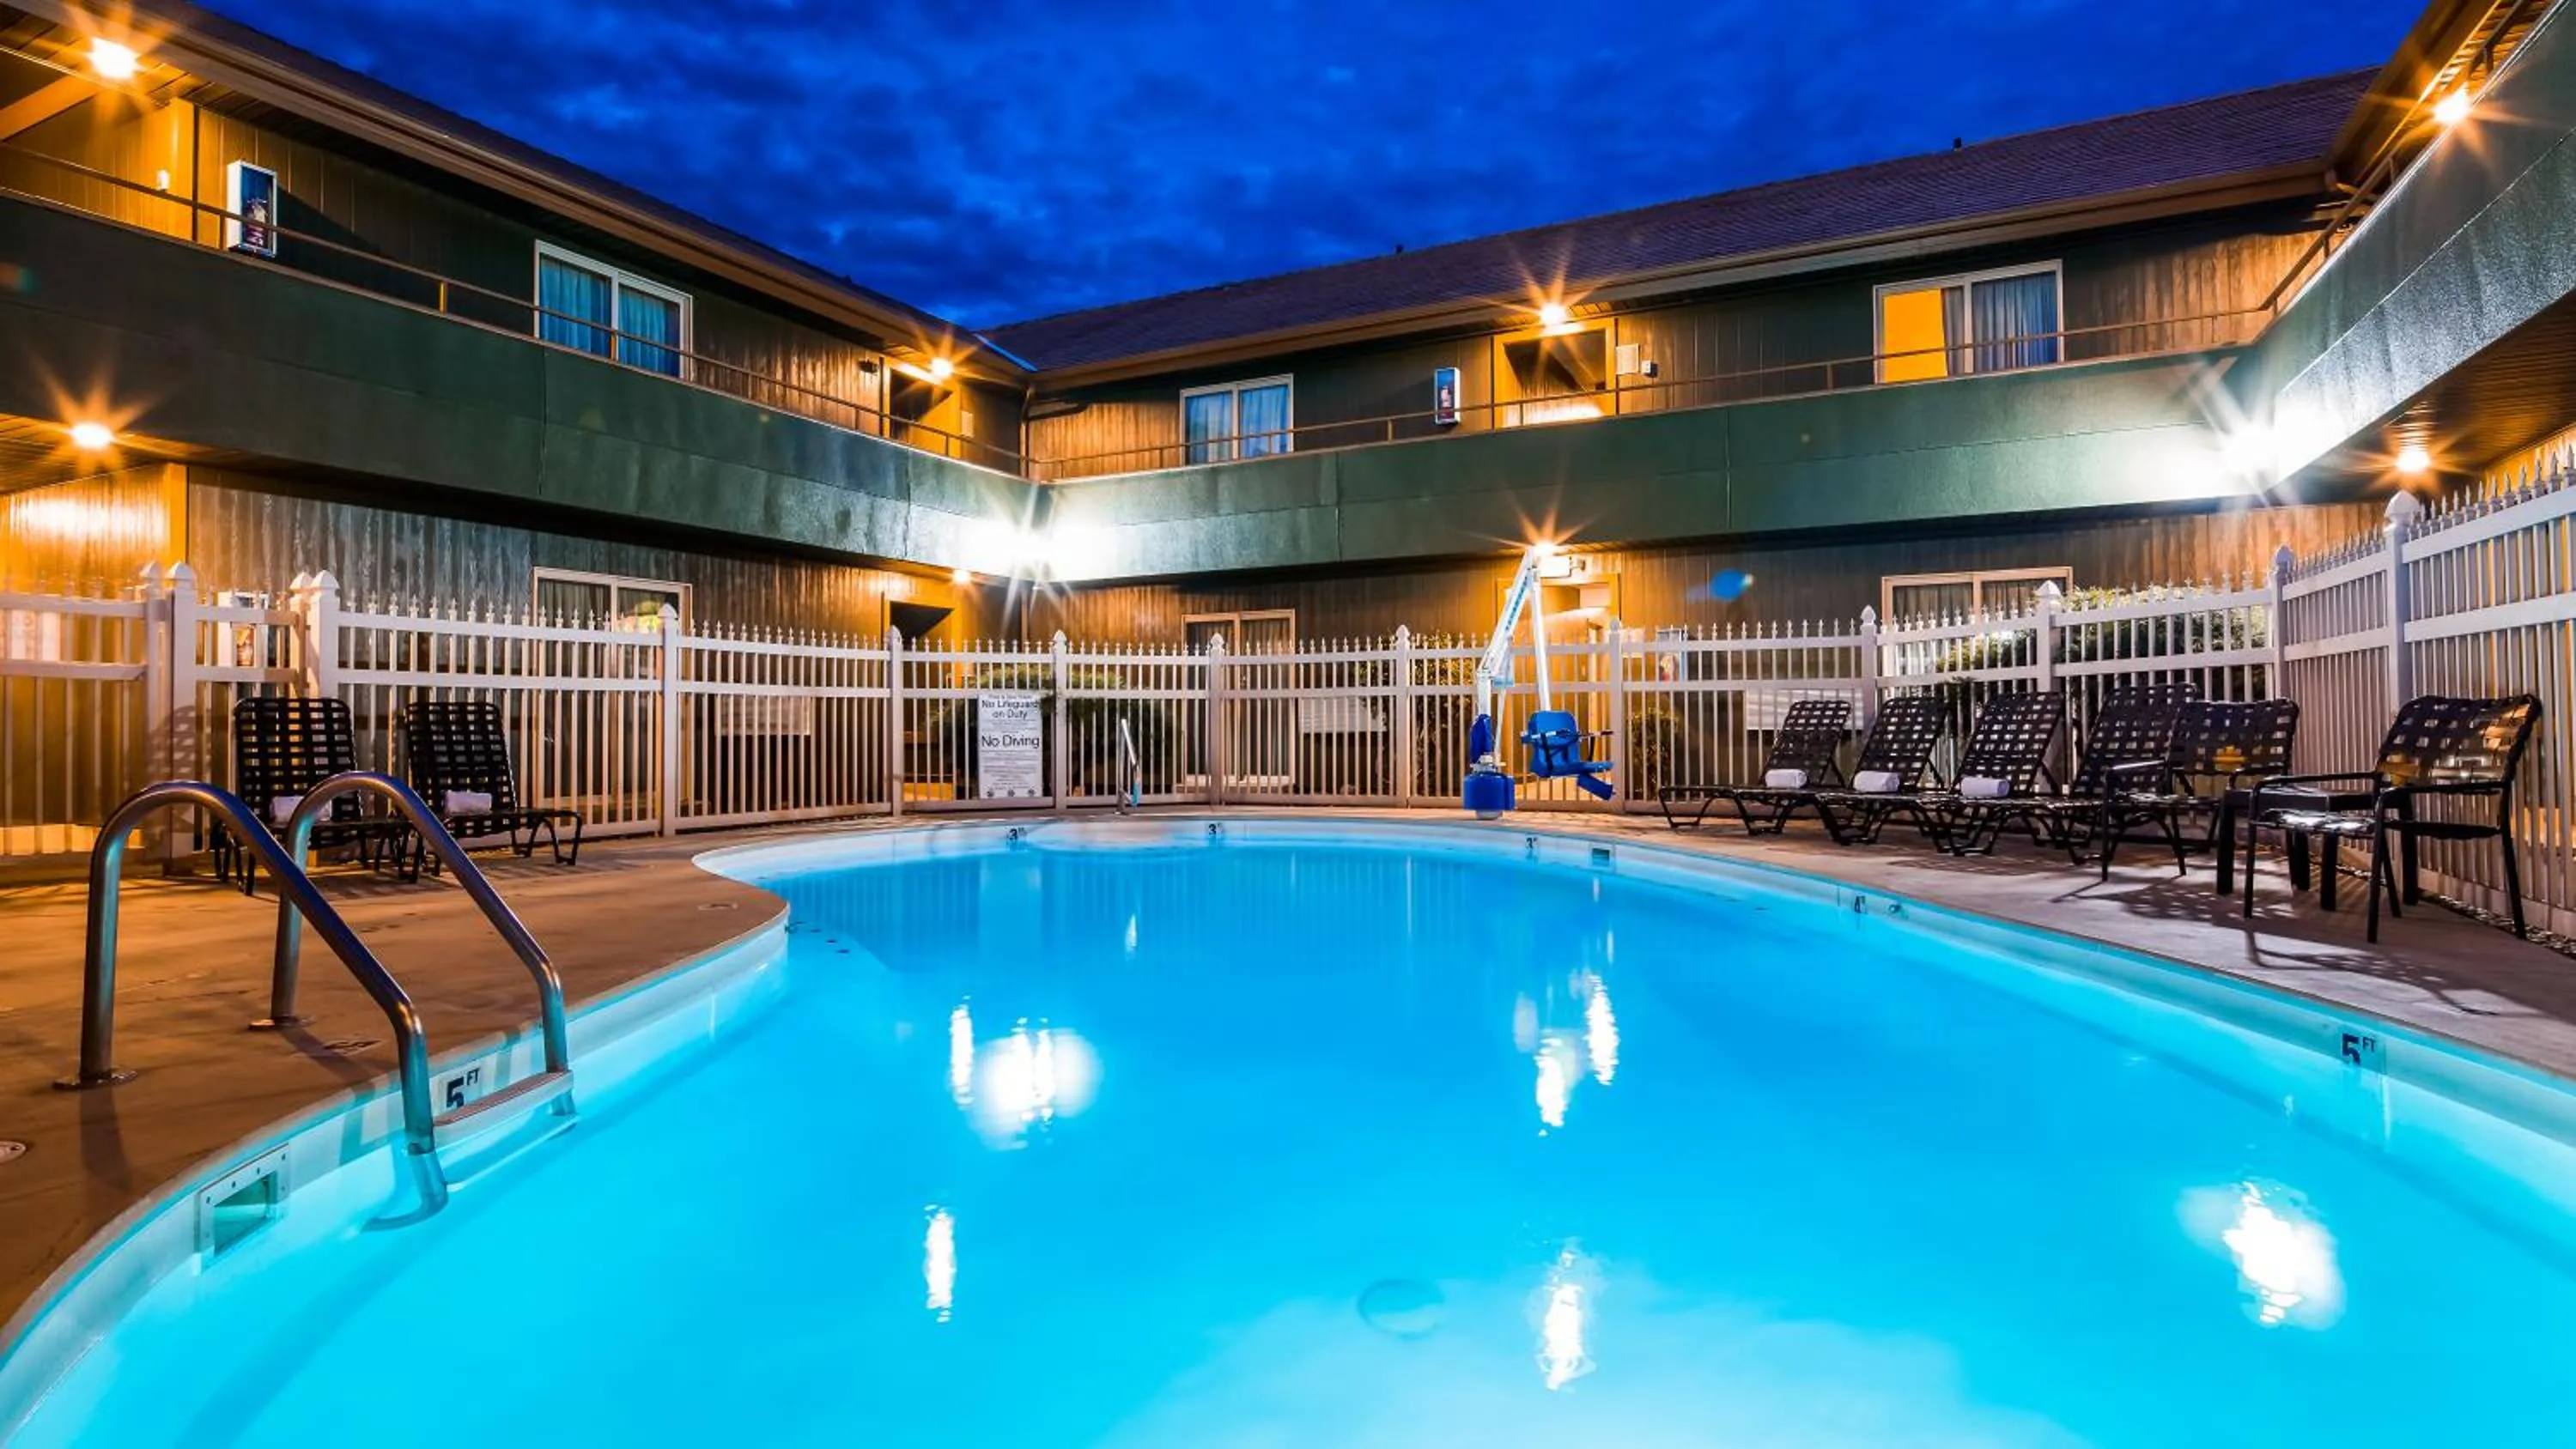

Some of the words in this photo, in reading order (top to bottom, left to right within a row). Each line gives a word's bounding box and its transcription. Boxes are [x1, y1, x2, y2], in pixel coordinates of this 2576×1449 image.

[981, 700, 995, 708] No
[998, 699, 1039, 710] Lifeguard
[1007, 709, 1028, 720] Duty
[981, 736, 999, 747] No
[1003, 735, 1040, 749] Diving
[2342, 1033, 2361, 1066] 5
[2362, 1036, 2376, 1052] FT
[446, 1076, 465, 1108] 5
[466, 1067, 480, 1086] FT
